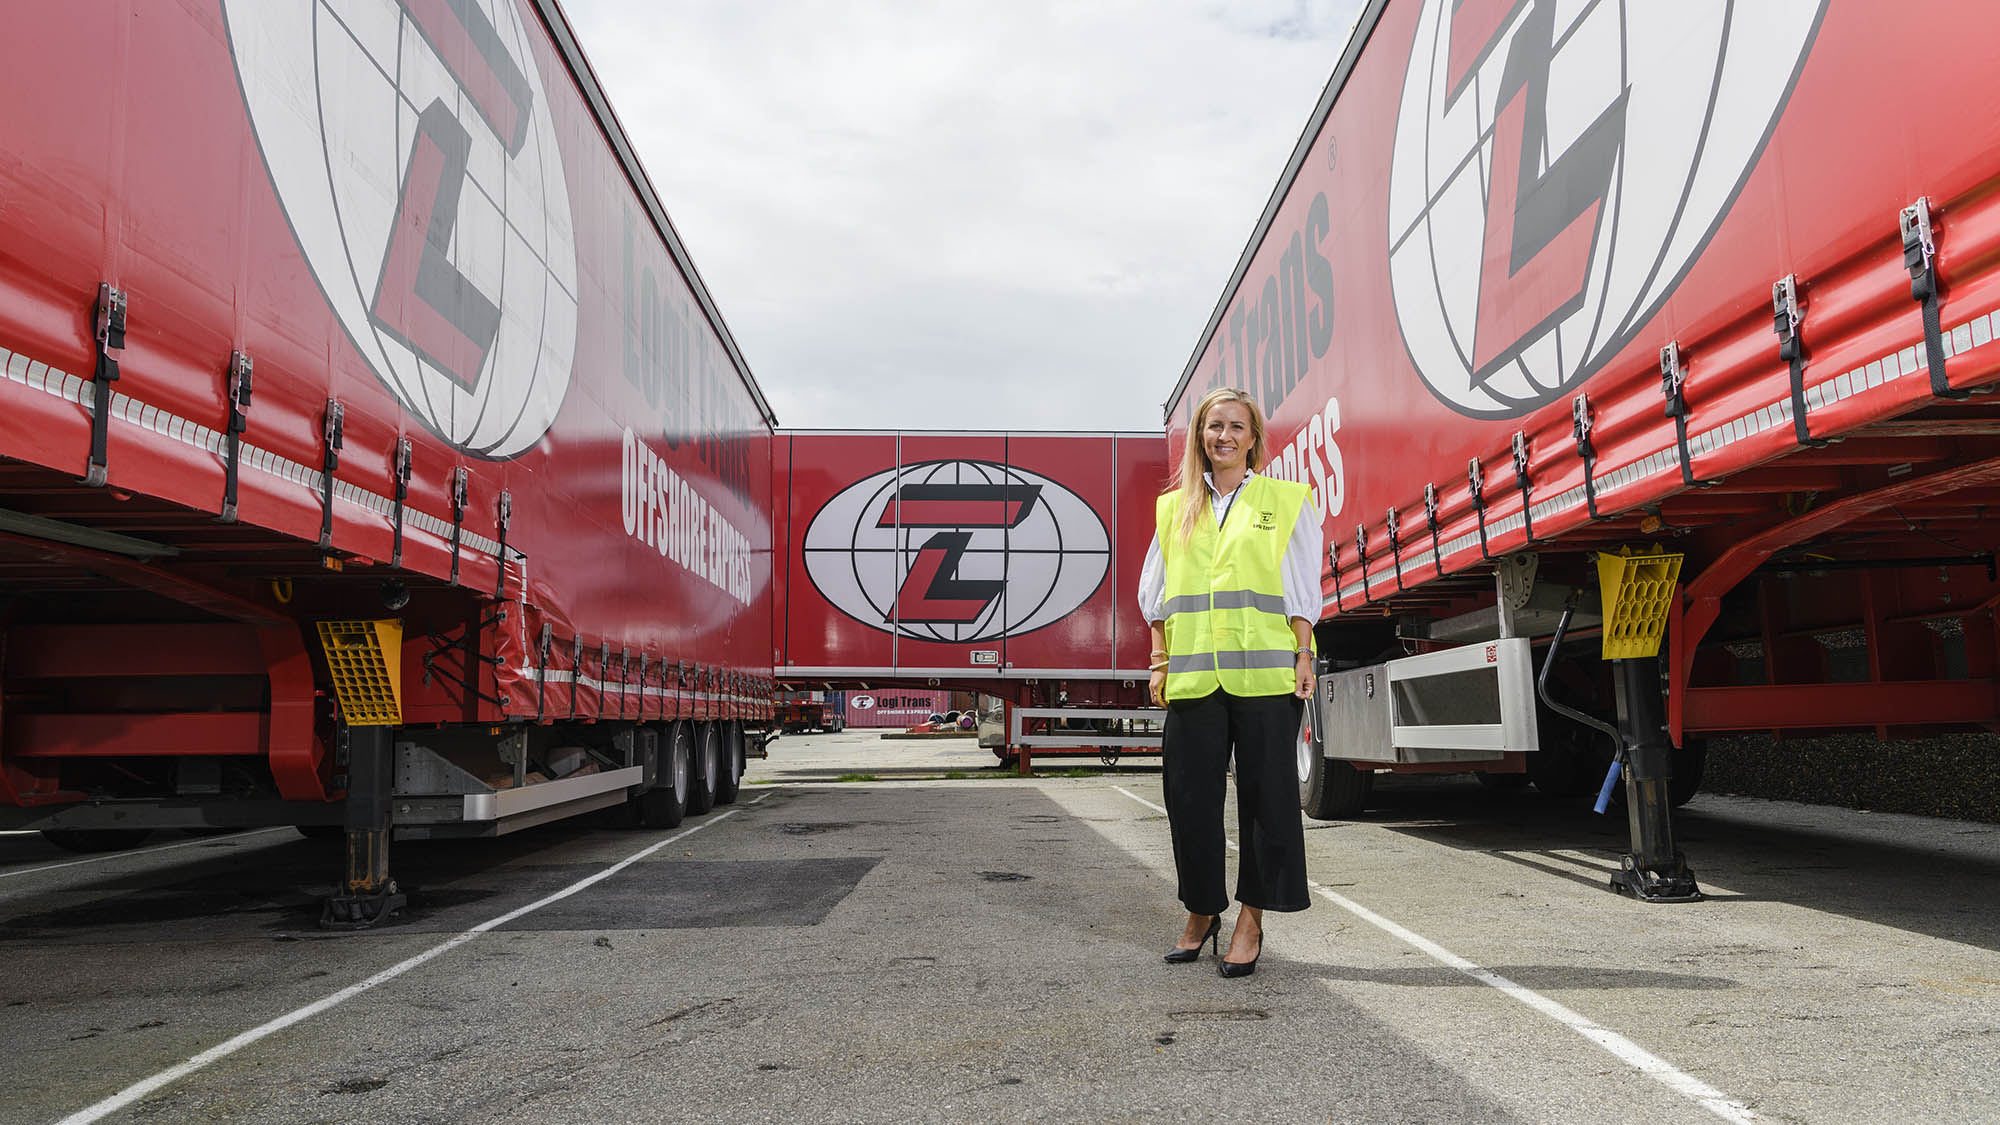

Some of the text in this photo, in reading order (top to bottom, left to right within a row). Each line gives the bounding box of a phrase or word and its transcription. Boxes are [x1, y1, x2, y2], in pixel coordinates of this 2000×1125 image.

[623, 198, 690, 452] Logi
[1229, 192, 1334, 420] Trans
[622, 425, 752, 608] OFFSHORE EXPRESS
[877, 696, 931, 708] Logi Trans
